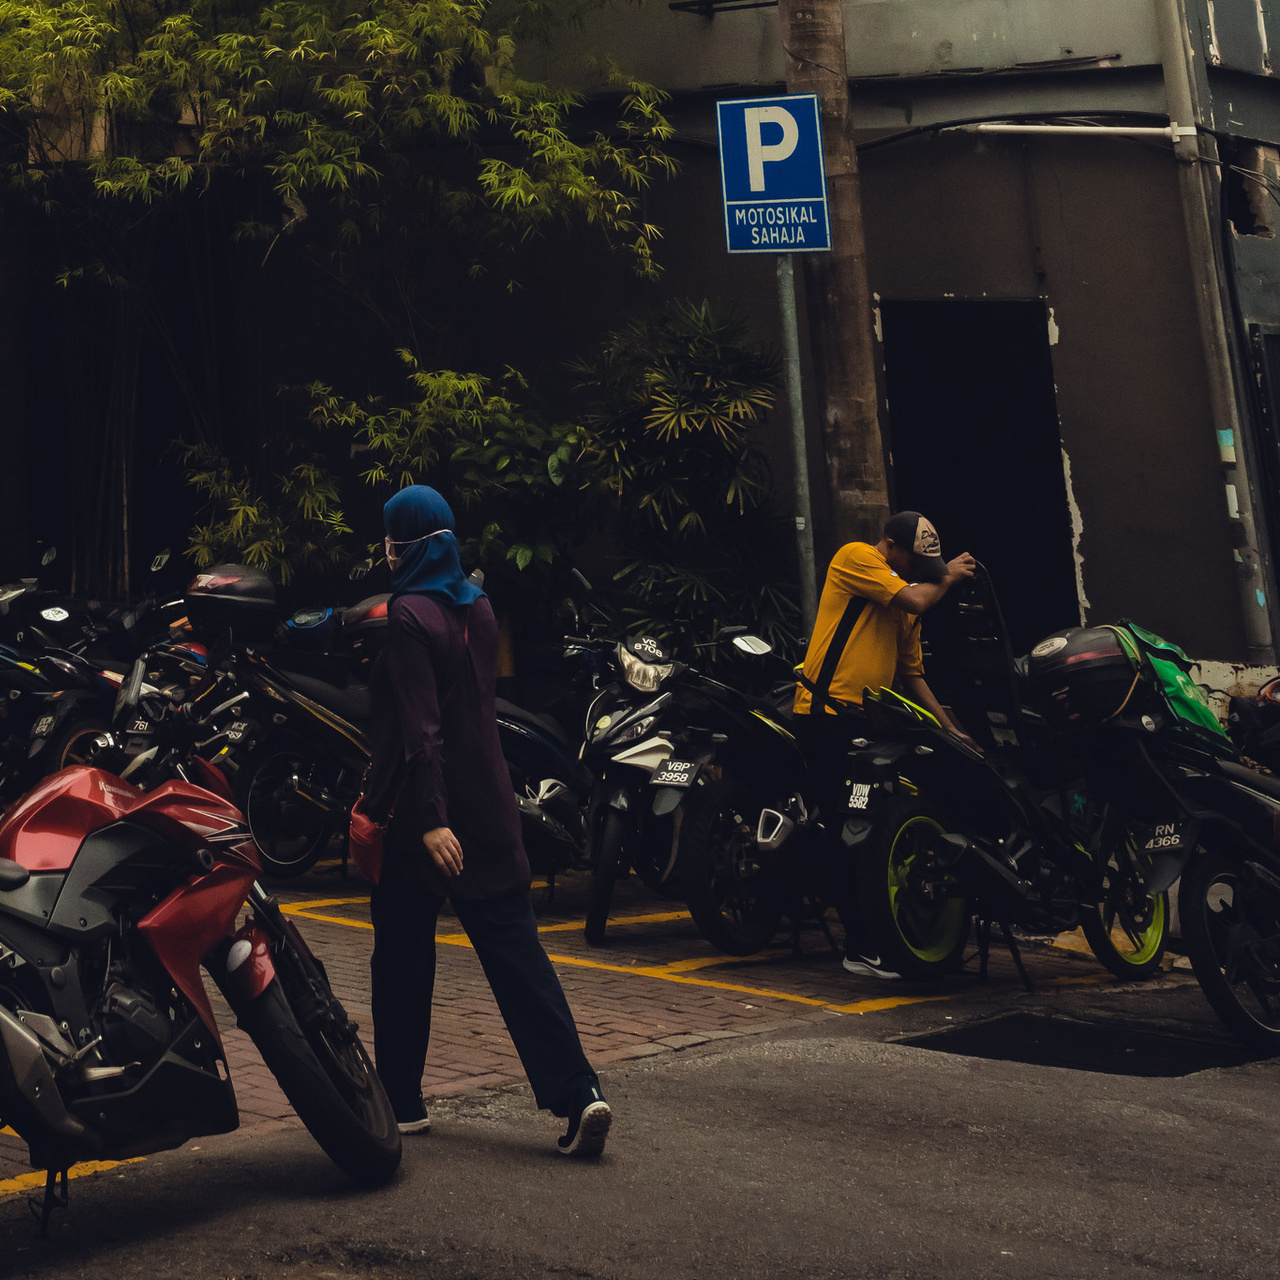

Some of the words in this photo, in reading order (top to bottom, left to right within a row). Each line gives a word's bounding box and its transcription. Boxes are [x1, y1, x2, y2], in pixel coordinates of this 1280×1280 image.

[744, 106, 799, 192] P
[735, 206, 817, 226] MOTOSIKAL
[751, 226, 806, 245] SAHAJA
[634, 643, 663, 658] 8708
[133, 720, 149, 731] 761
[667, 761, 691, 772] VBP
[657, 771, 689, 783] 3958
[852, 783, 871, 797] VDW
[848, 794, 869, 810] 5582
[1155, 823, 1175, 836] RN
[1145, 834, 1181, 849] 4366
